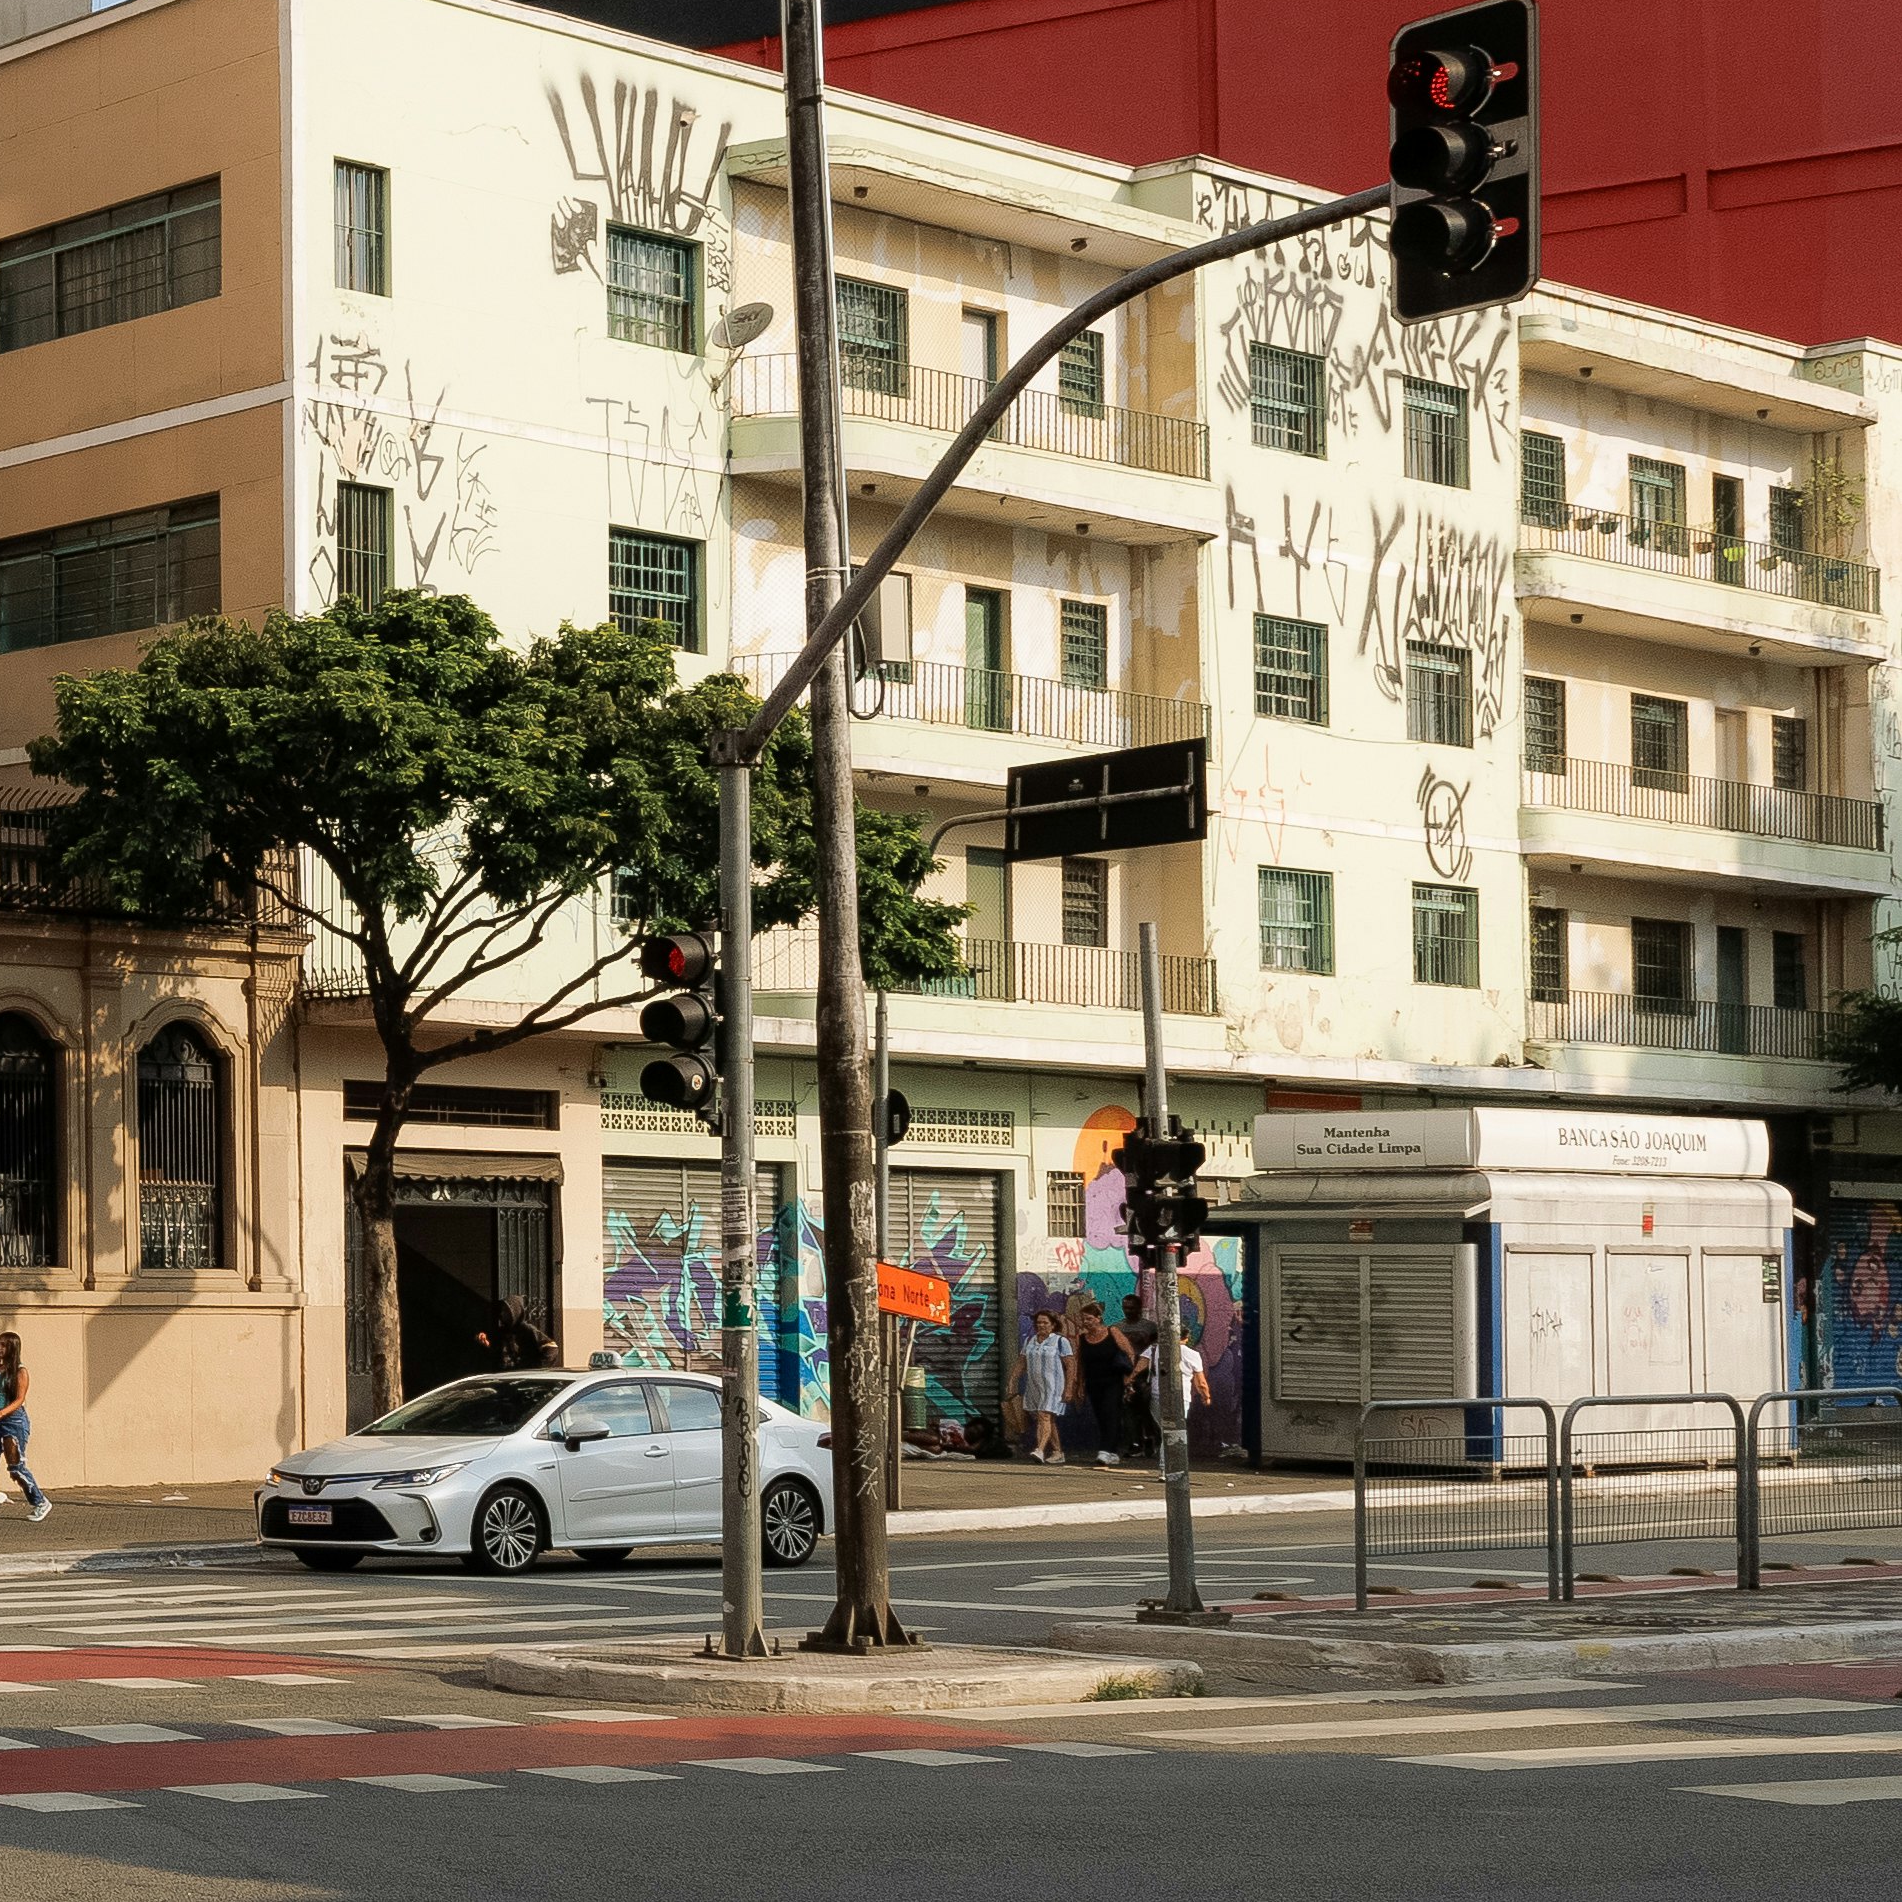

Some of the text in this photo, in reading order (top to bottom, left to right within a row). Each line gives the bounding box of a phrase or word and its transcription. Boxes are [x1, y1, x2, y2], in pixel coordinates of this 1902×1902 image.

[1323, 1126, 1391, 1139] Mantenha
[1557, 1124, 1707, 1154] BANCA SÃO JOAQUIM
[1296, 1142, 1422, 1156] Sua Cidade Limpa
[878, 1283, 930, 1308] ona Norte
[591, 1353, 614, 1365] TAXI
